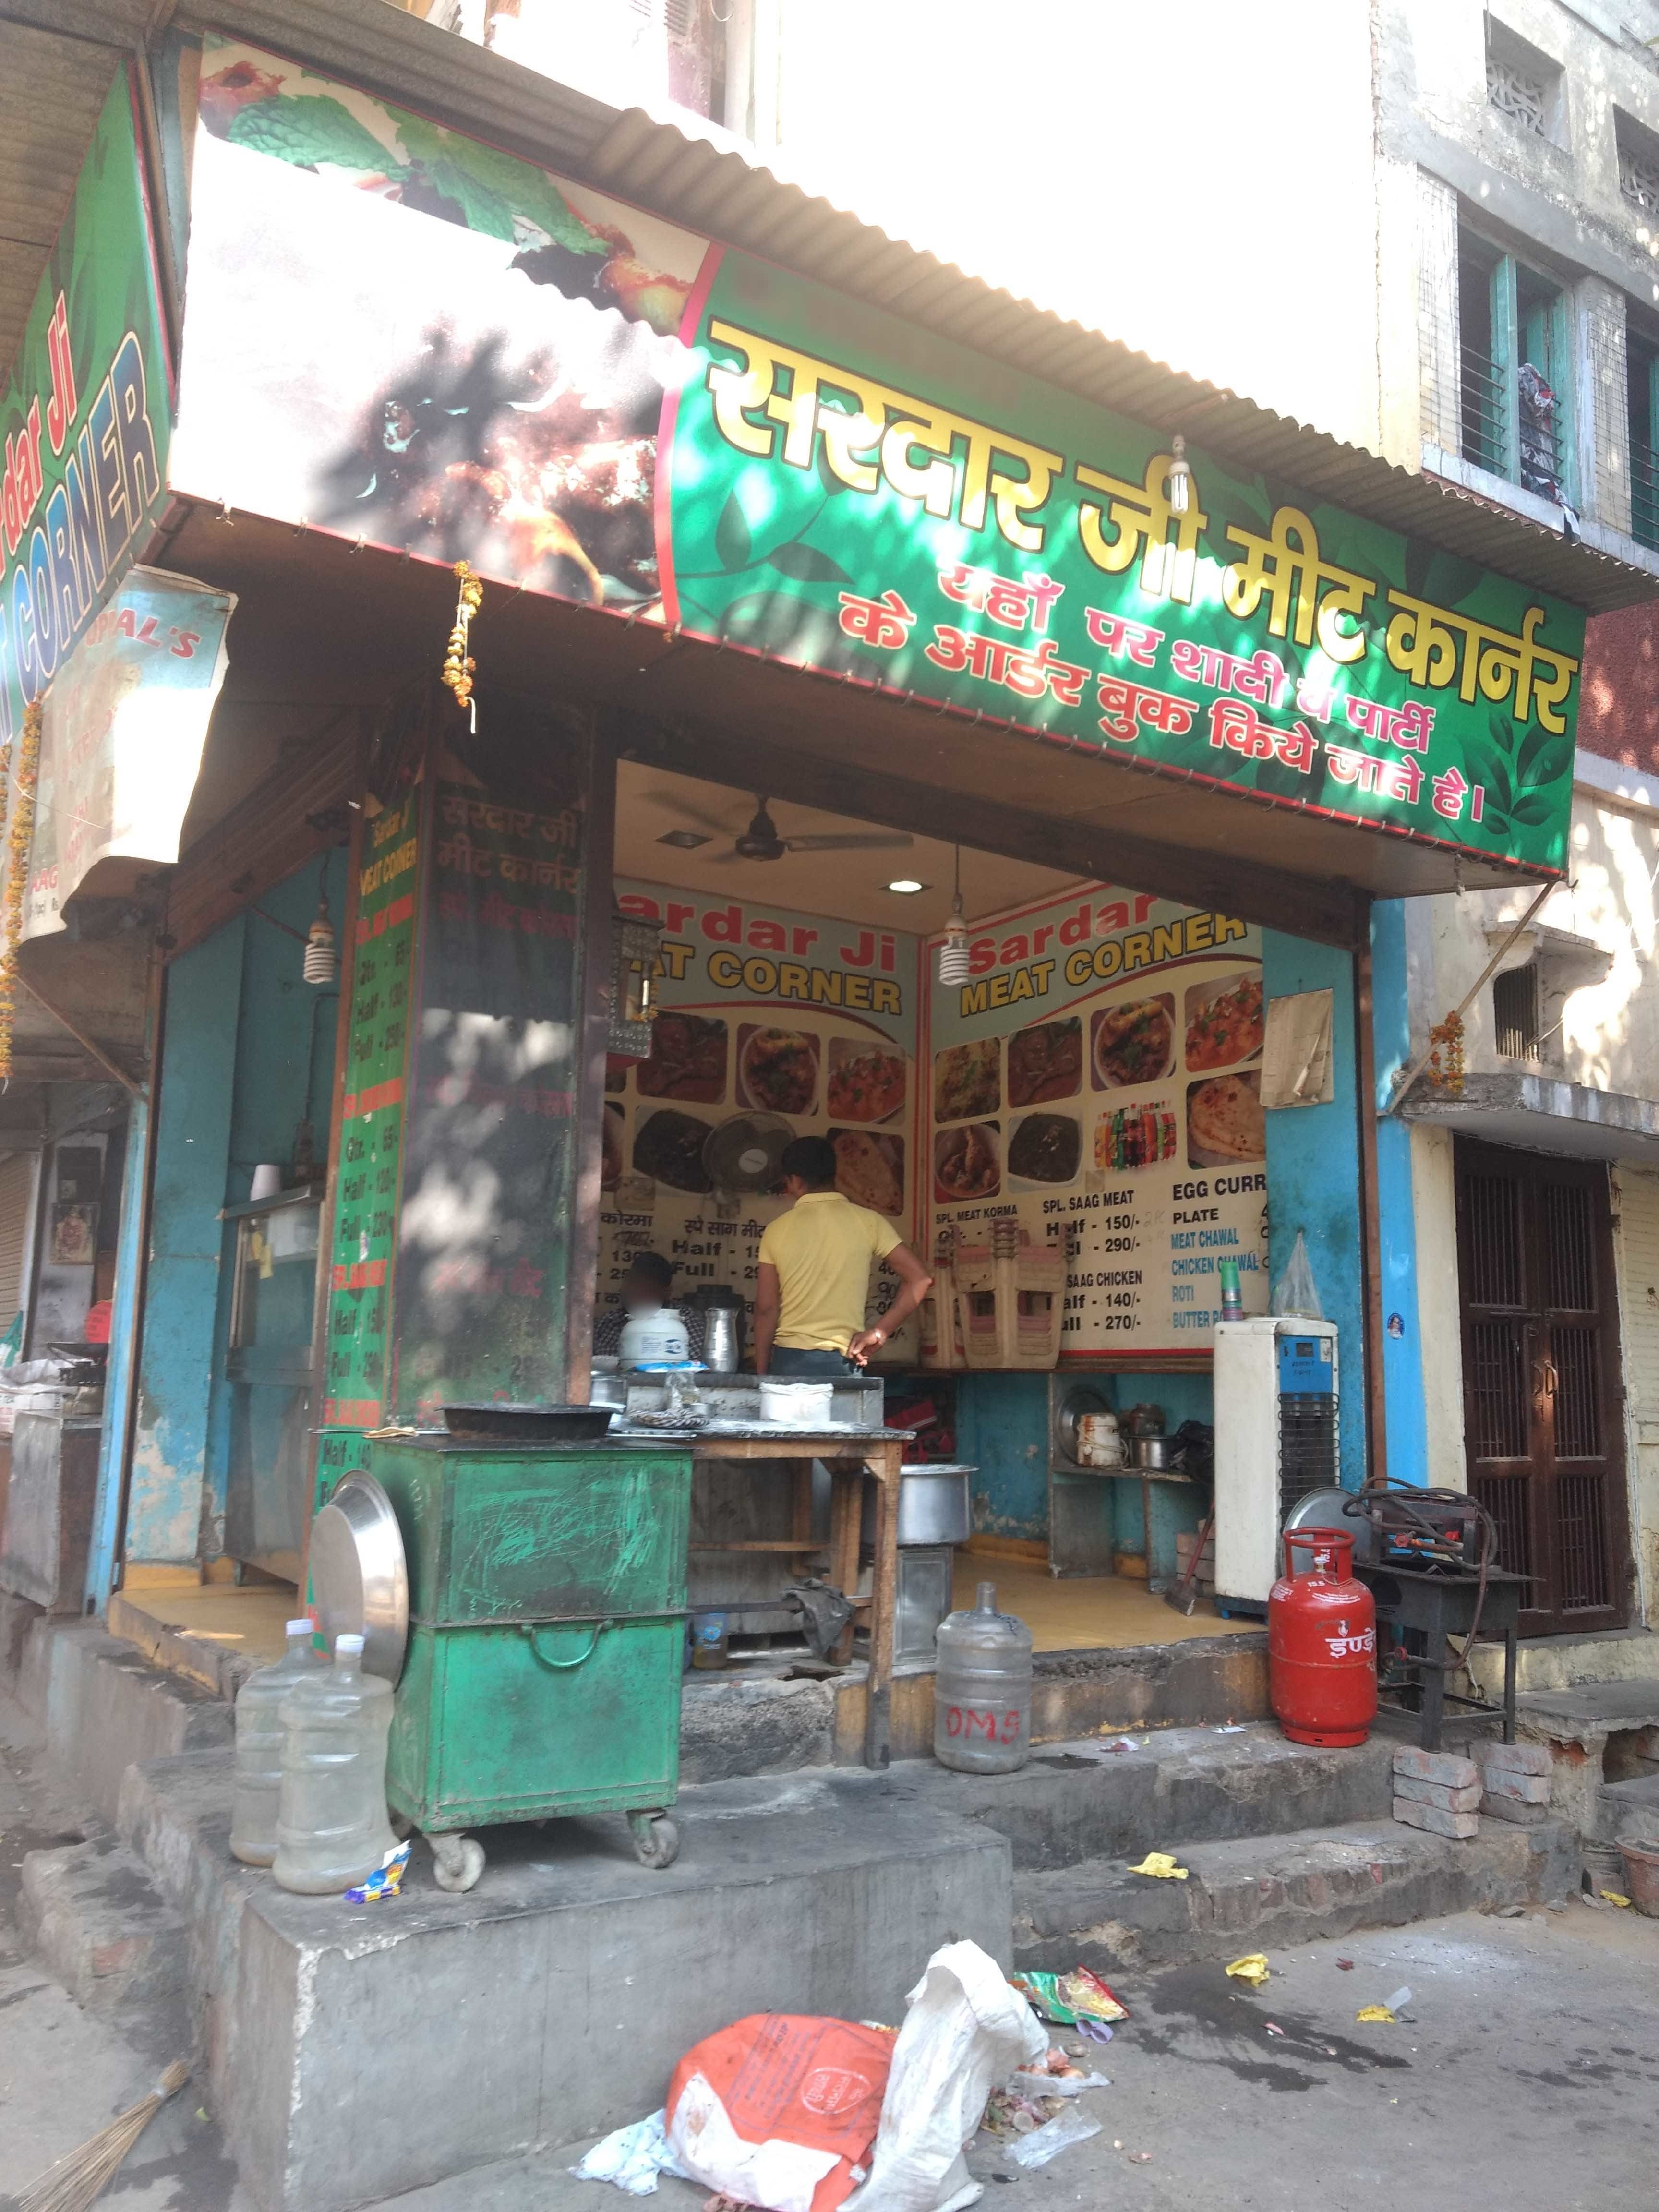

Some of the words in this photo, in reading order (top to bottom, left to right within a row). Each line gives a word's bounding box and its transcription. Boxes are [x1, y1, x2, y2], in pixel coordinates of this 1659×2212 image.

[46, 289, 78, 457] Ji
[12, 330, 161, 709] CORNER
[708, 314, 1064, 553] सरदार
[1074, 452, 1207, 606] जी
[1222, 506, 1377, 663] मीट
[1385, 607, 1578, 735] कार्नर
[937, 557, 1064, 633] यहाँ
[1085, 607, 1165, 668] पर
[1171, 639, 1289, 709] शादी
[1344, 699, 1436, 754] पार्टी
[839, 590, 916, 650] के
[925, 623, 1092, 707] आर्डर
[1096, 673, 1199, 742] बुक
[1208, 697, 1319, 775] किये
[1324, 744, 1424, 804] जाते
[618, 894, 818, 956] ardar
[840, 931, 896, 973] Ji
[967, 894, 1158, 976] Sardar
[708, 950, 902, 1016] CORNER
[960, 959, 1056, 1019] MEAT
[1172, 1180, 1209, 1201] EGG
[1214, 1173, 1267, 1196] CURR
[1043, 1198, 1066, 1214] SPL.
[1069, 1194, 1100, 1211] SAAG
[1103, 1190, 1134, 1207] MEAT
[600, 1209, 653, 1227] कोरमा
[957, 1209, 981, 1222] MEAT
[983, 1204, 1018, 1218] KORMA
[1105, 1213, 1140, 1230] 150/-
[1173, 1208, 1219, 1224] PLATE
[707, 1221, 738, 1237] साग
[672, 1239, 721, 1256] Half
[1105, 1236, 1140, 1253] 290/-
[1171, 1232, 1196, 1250] MEAT
[1198, 1228, 1239, 1248] CHAWAL
[671, 1261, 715, 1277] Full
[1171, 1256, 1214, 1276] CHICKEN
[1066, 1273, 1094, 1288] SAAG
[1096, 1270, 1143, 1287] CHICKEN
[1106, 1291, 1140, 1308] 140/-
[1172, 1285, 1194, 1302] ROTI
[1105, 1314, 1141, 1331] 270/-
[1173, 1310, 1210, 1329] BUTTER
